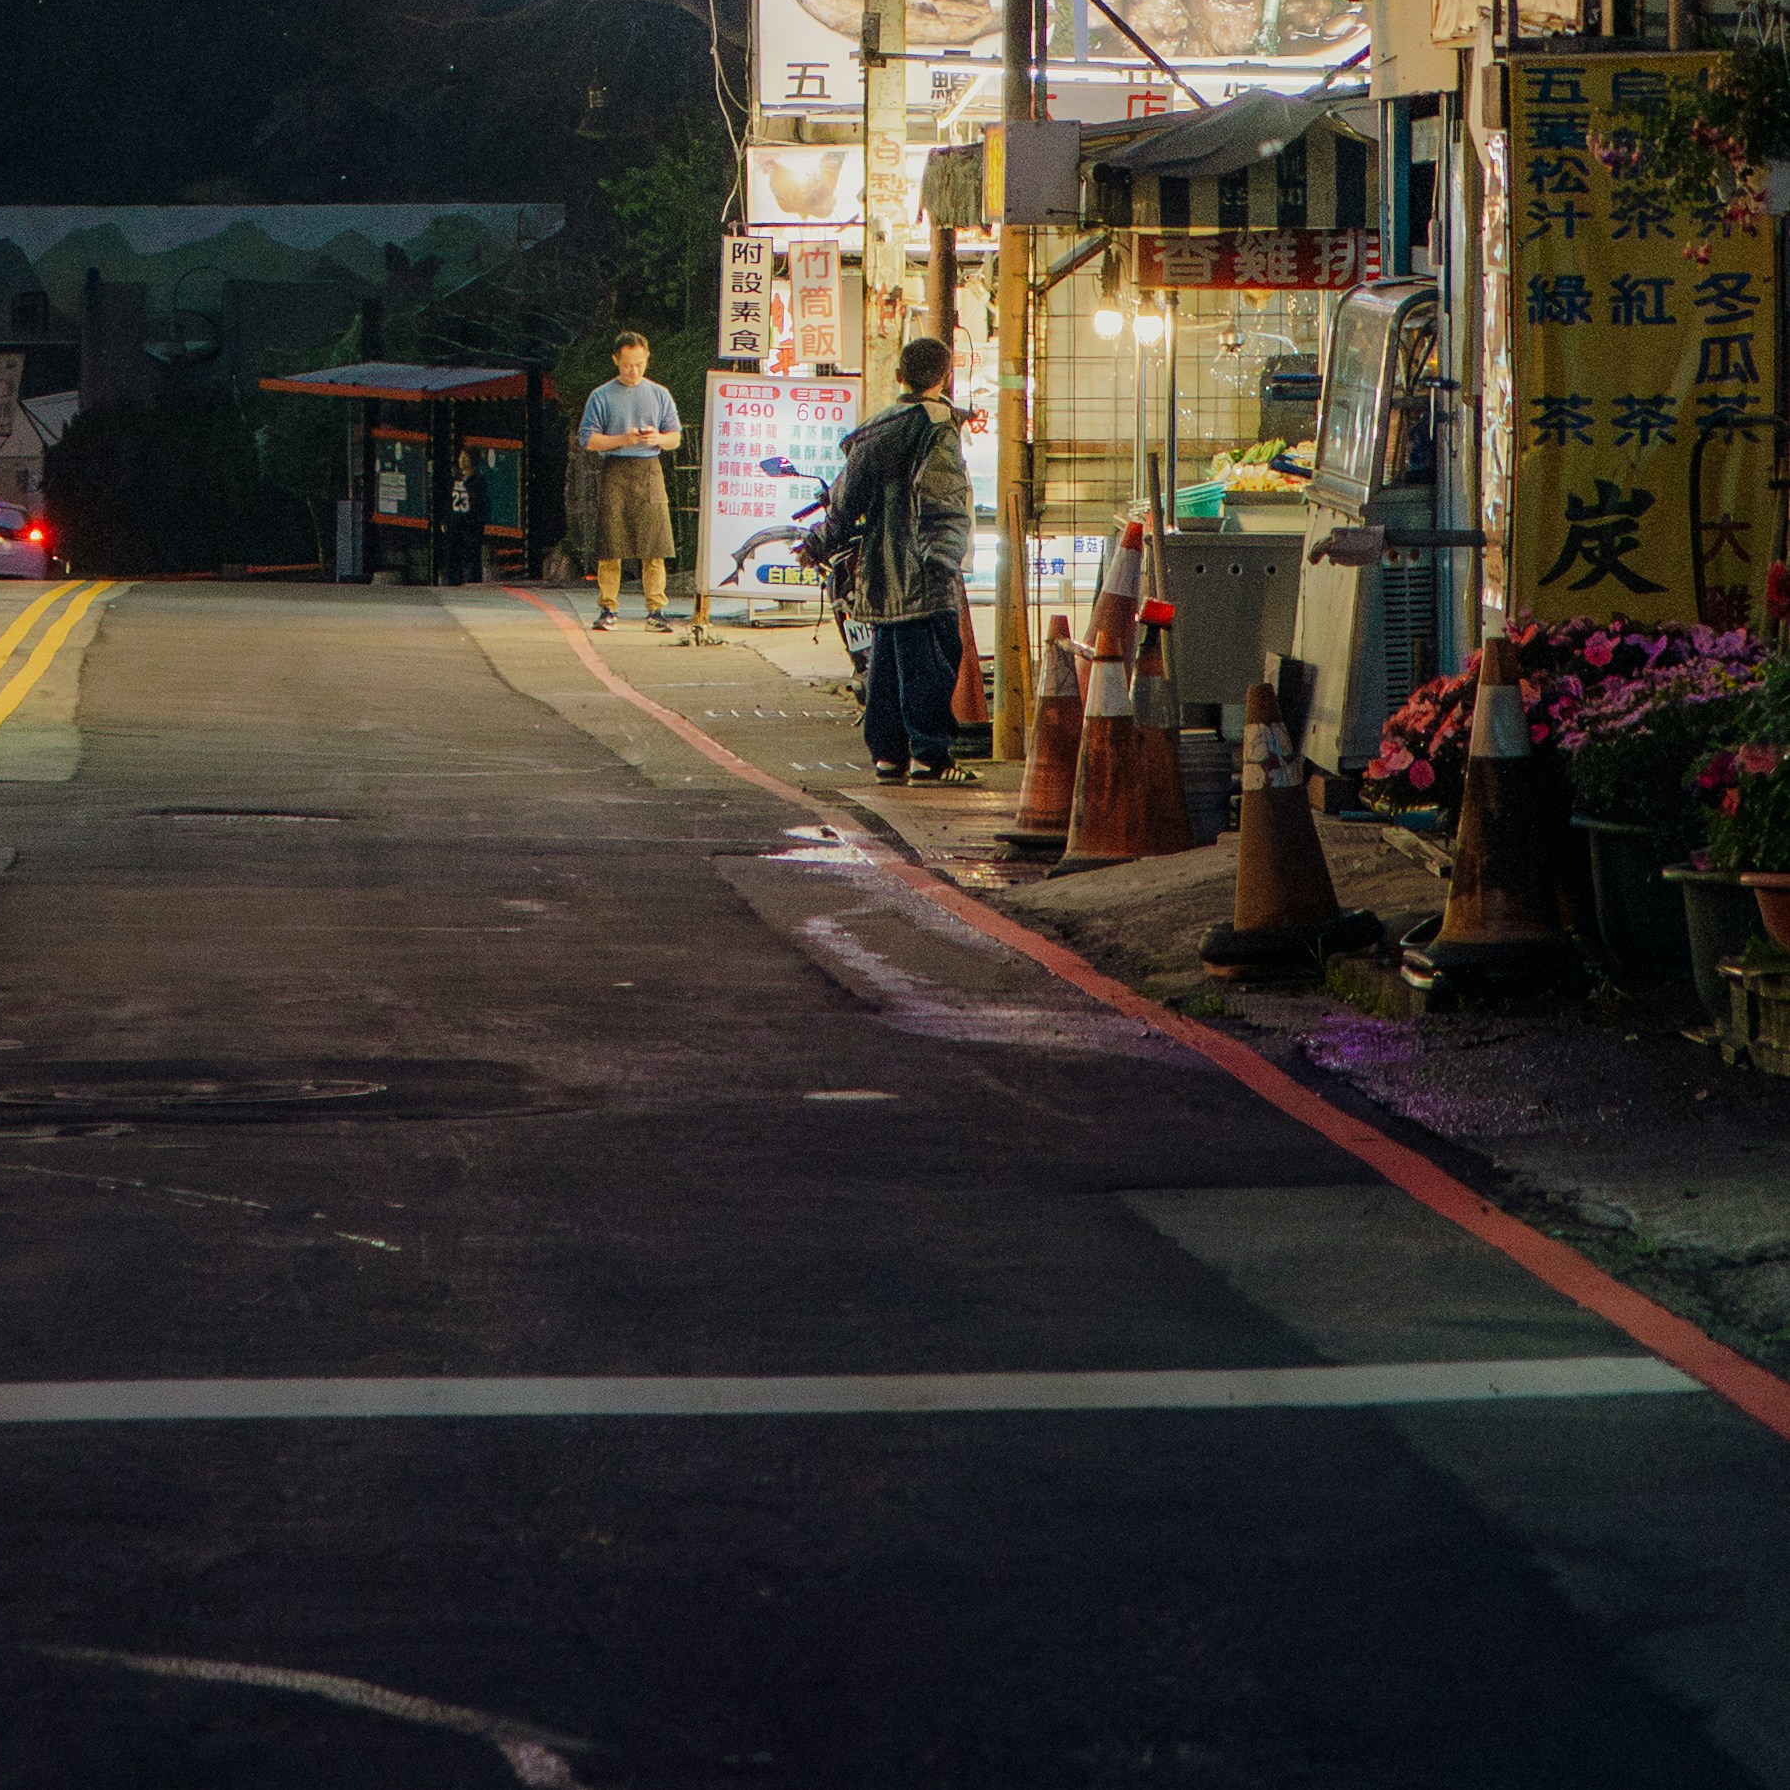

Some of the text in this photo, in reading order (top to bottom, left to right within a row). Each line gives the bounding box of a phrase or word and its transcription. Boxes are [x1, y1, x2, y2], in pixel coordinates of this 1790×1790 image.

[729, 242, 763, 353] 附設素食
[797, 247, 836, 357] 竹筒飯
[724, 402, 844, 421] 1490 600
[451, 490, 470, 513] 23
